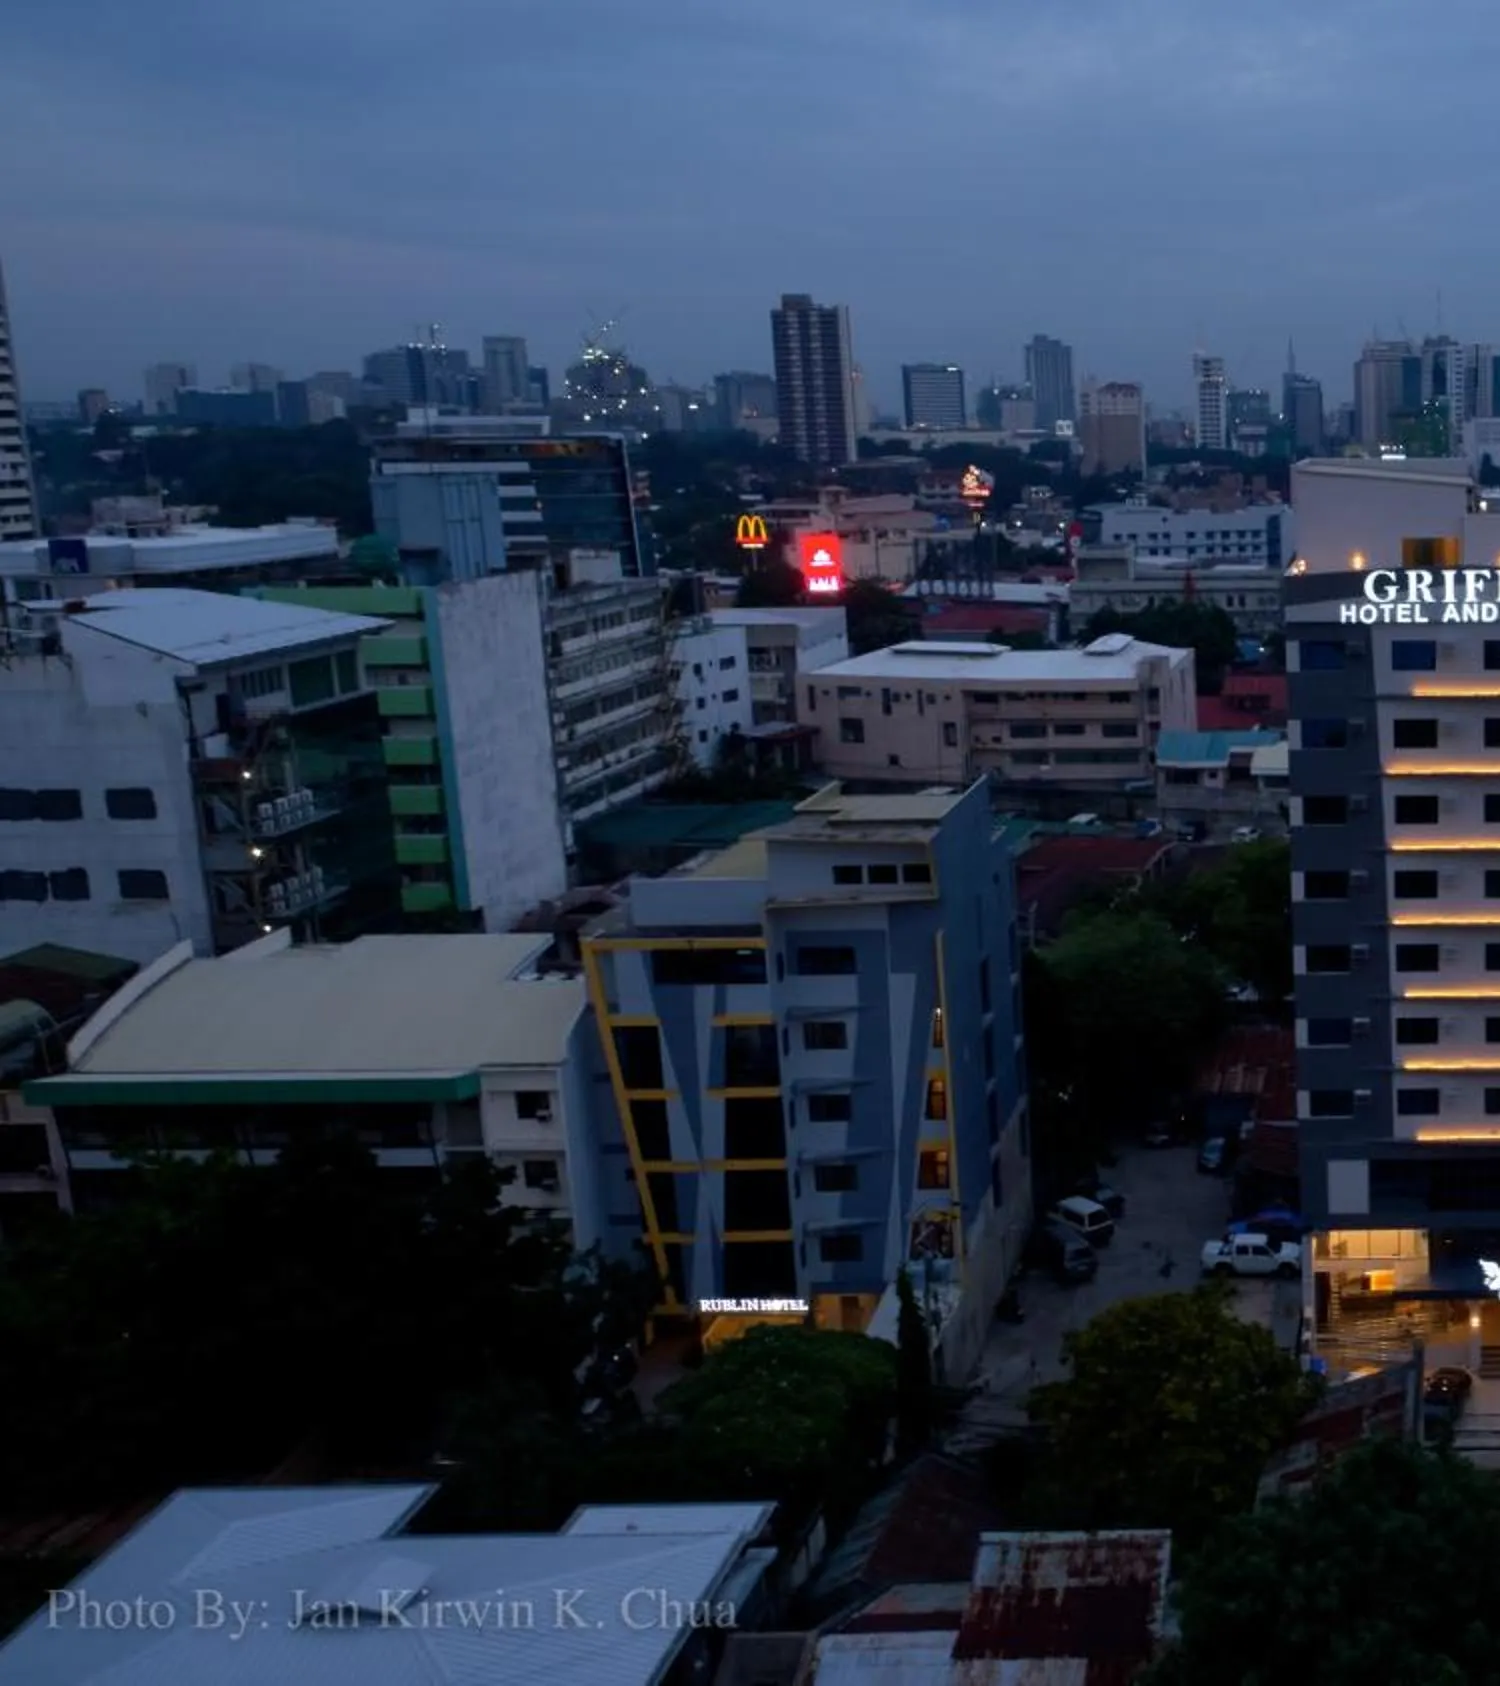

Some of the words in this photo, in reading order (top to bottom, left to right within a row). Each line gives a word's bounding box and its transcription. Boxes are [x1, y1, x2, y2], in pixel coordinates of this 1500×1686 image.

[1339, 603, 1429, 624] HOTEL
[1442, 602, 1498, 624] AND
[700, 1298, 759, 1312] RUBLIN
[760, 1299, 809, 1311] HOTEL
